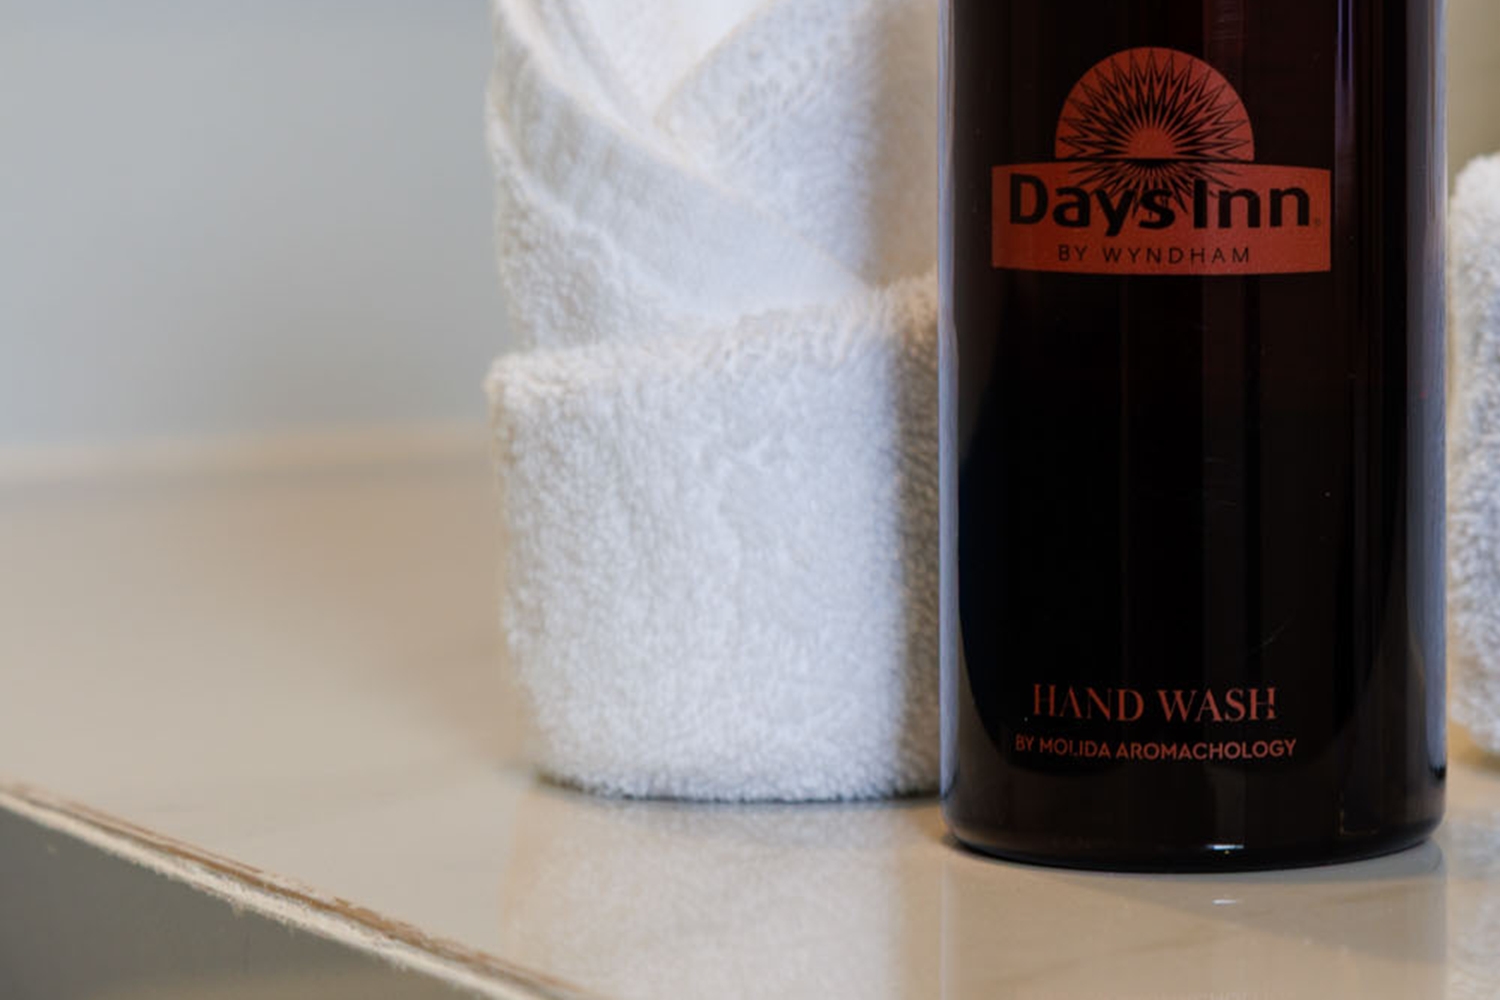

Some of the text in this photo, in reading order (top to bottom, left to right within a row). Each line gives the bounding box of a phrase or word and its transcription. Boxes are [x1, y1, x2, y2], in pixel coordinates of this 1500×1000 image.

[1009, 172, 1310, 237] Days Inn
[1058, 244, 1250, 265] BY WYNDHAM
[1032, 683, 1277, 723] HAND WASH
[1015, 733, 1297, 761] BY MOLIDA AROMACHOLOGY
